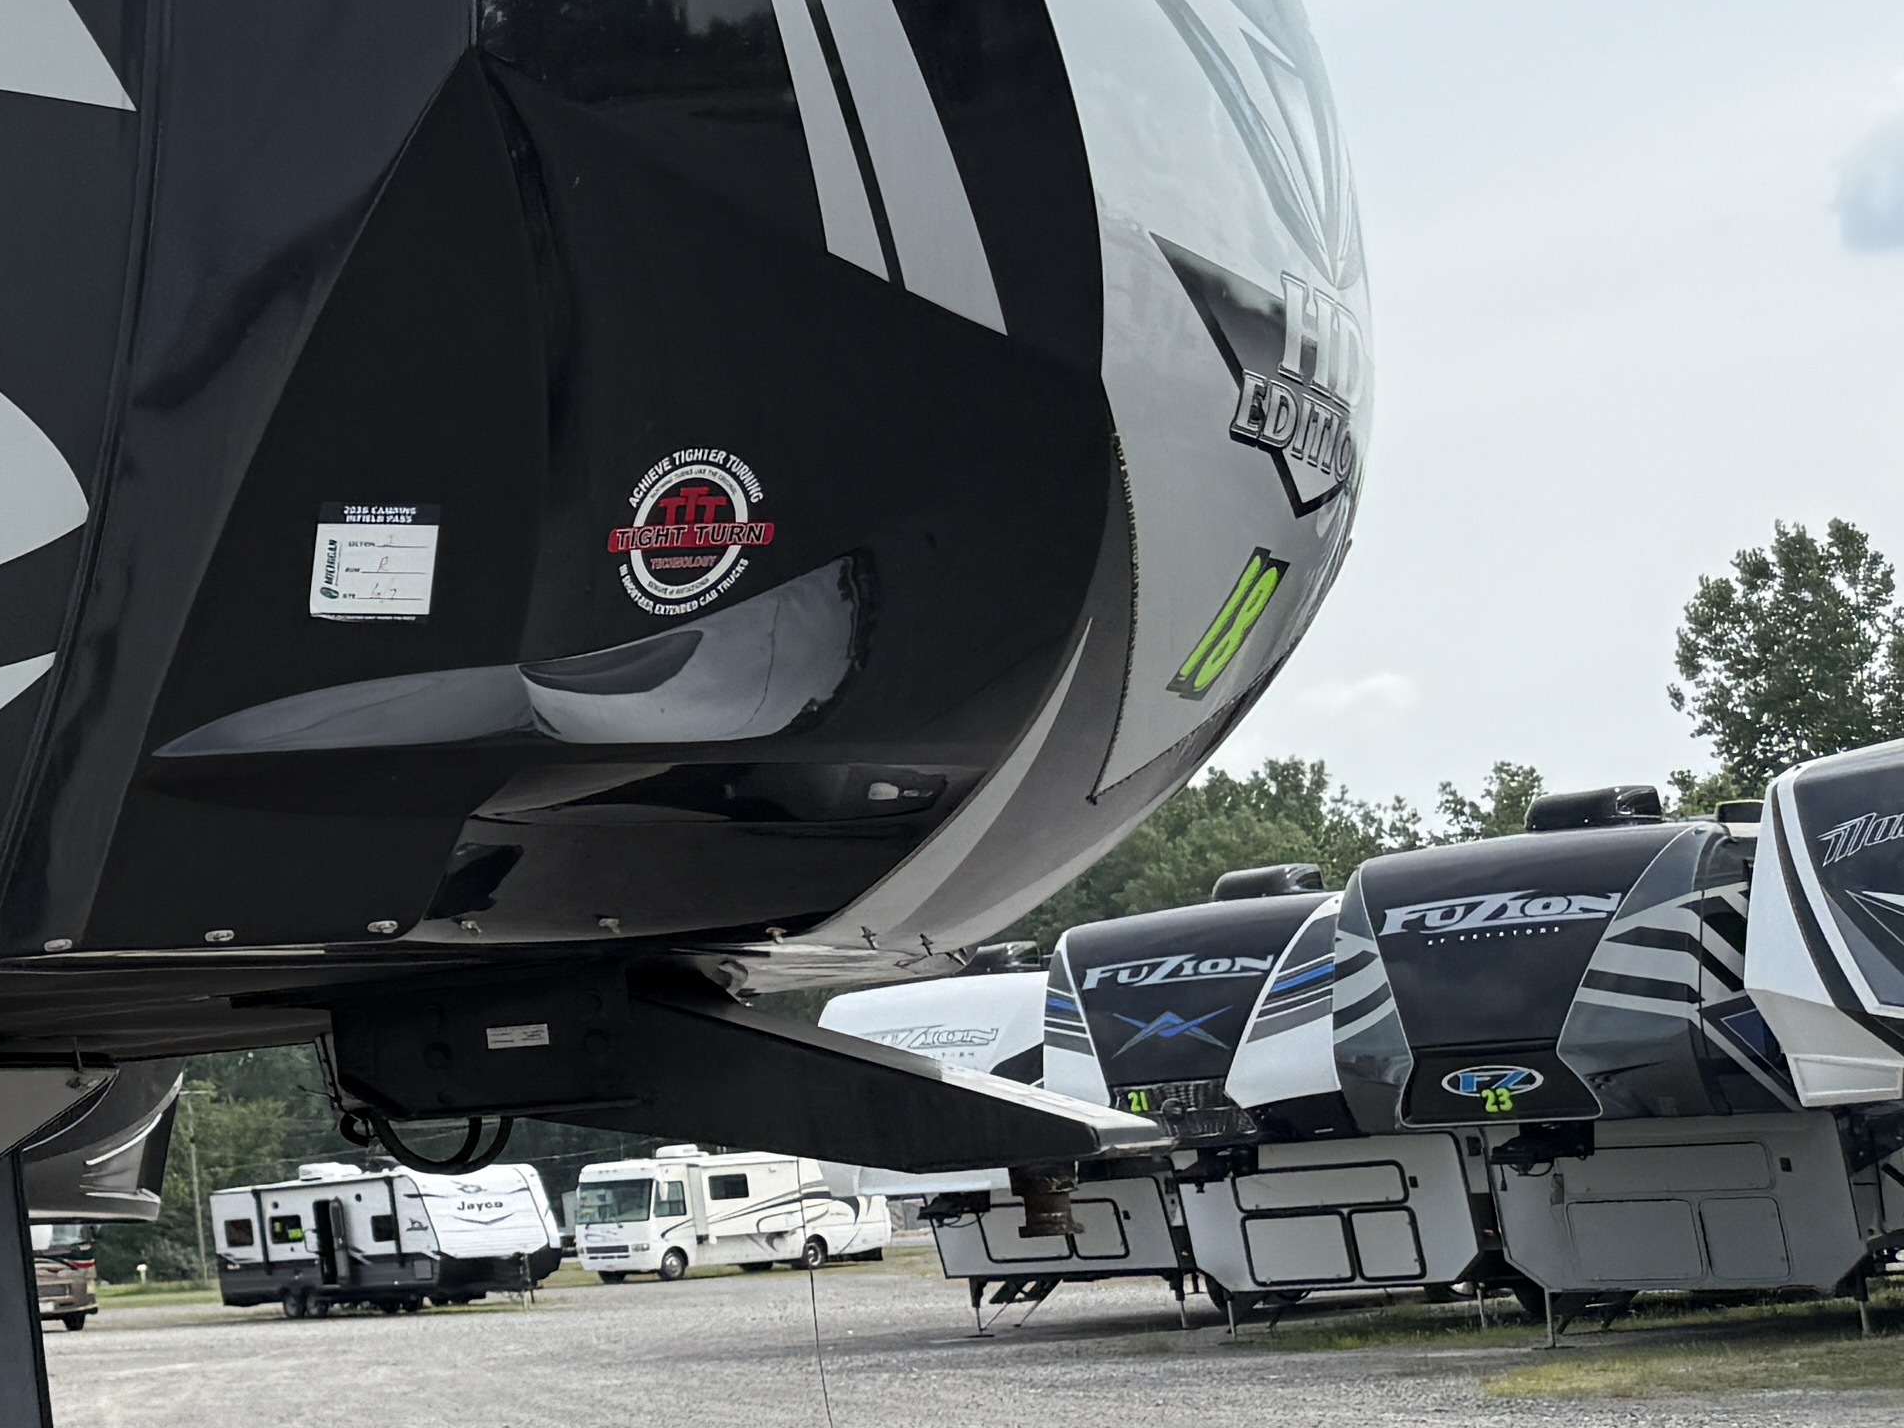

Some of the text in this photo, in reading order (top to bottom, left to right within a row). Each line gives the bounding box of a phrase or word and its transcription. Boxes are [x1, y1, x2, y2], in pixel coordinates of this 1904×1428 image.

[1277, 270, 1364, 413] HD
[1229, 368, 1353, 484] EDITIO
[628, 457, 673, 508] ACHIEVE
[673, 448, 727, 466] TIGHTER
[726, 454, 765, 505] TURNING
[616, 523, 766, 551] TIGHT TURN
[654, 600, 699, 616] EXTENDED
[699, 590, 719, 607] CAB
[717, 558, 749, 594] TRUCKS
[1178, 554, 1280, 693] 18
[861, 1024, 1000, 1049] UZION
[1127, 1091, 1151, 1113] 21
[1481, 1088, 1514, 1113] 23
[457, 1201, 504, 1212] Jayco
